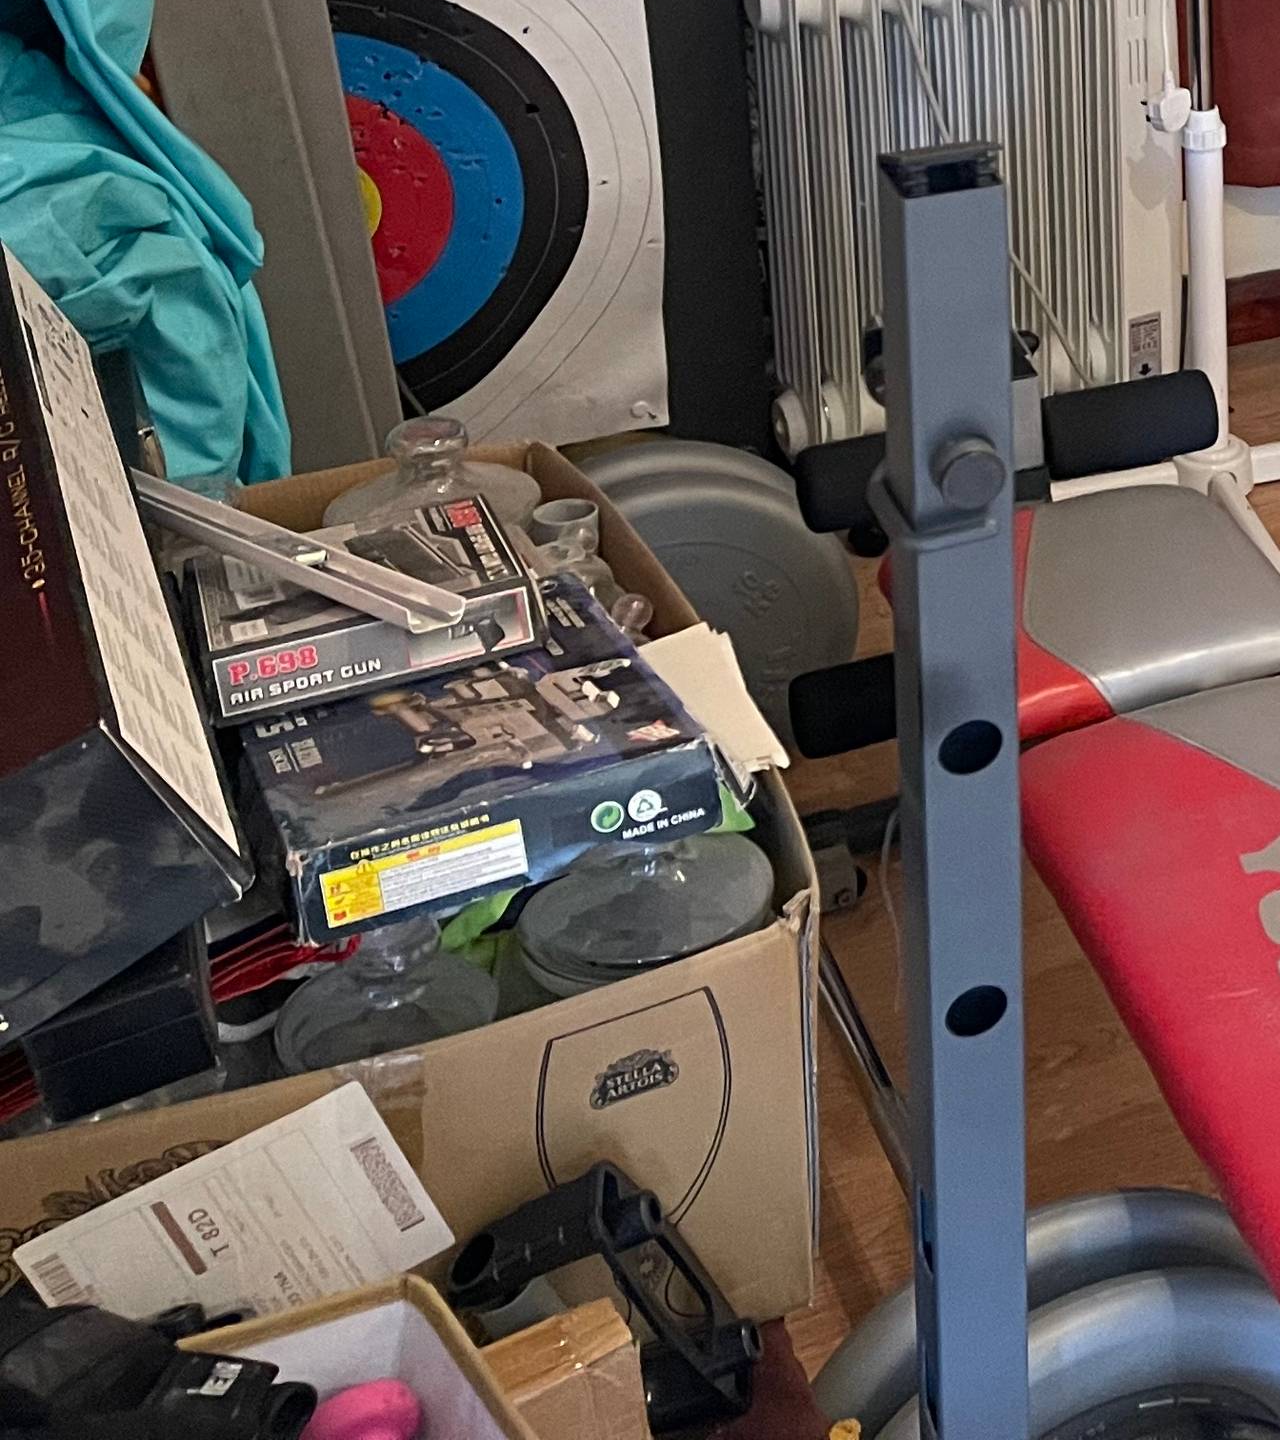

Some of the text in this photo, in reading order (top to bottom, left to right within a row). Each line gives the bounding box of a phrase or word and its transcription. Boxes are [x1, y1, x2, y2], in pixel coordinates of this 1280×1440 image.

[227, 644, 319, 687] P.698
[230, 657, 382, 706] AIR SPORT GUN
[622, 807, 706, 840] MADE IN CHINA
[606, 1061, 662, 1089] STELLA
[607, 1072, 663, 1099] ARTOIS
[187, 1207, 230, 1257] T 82D
